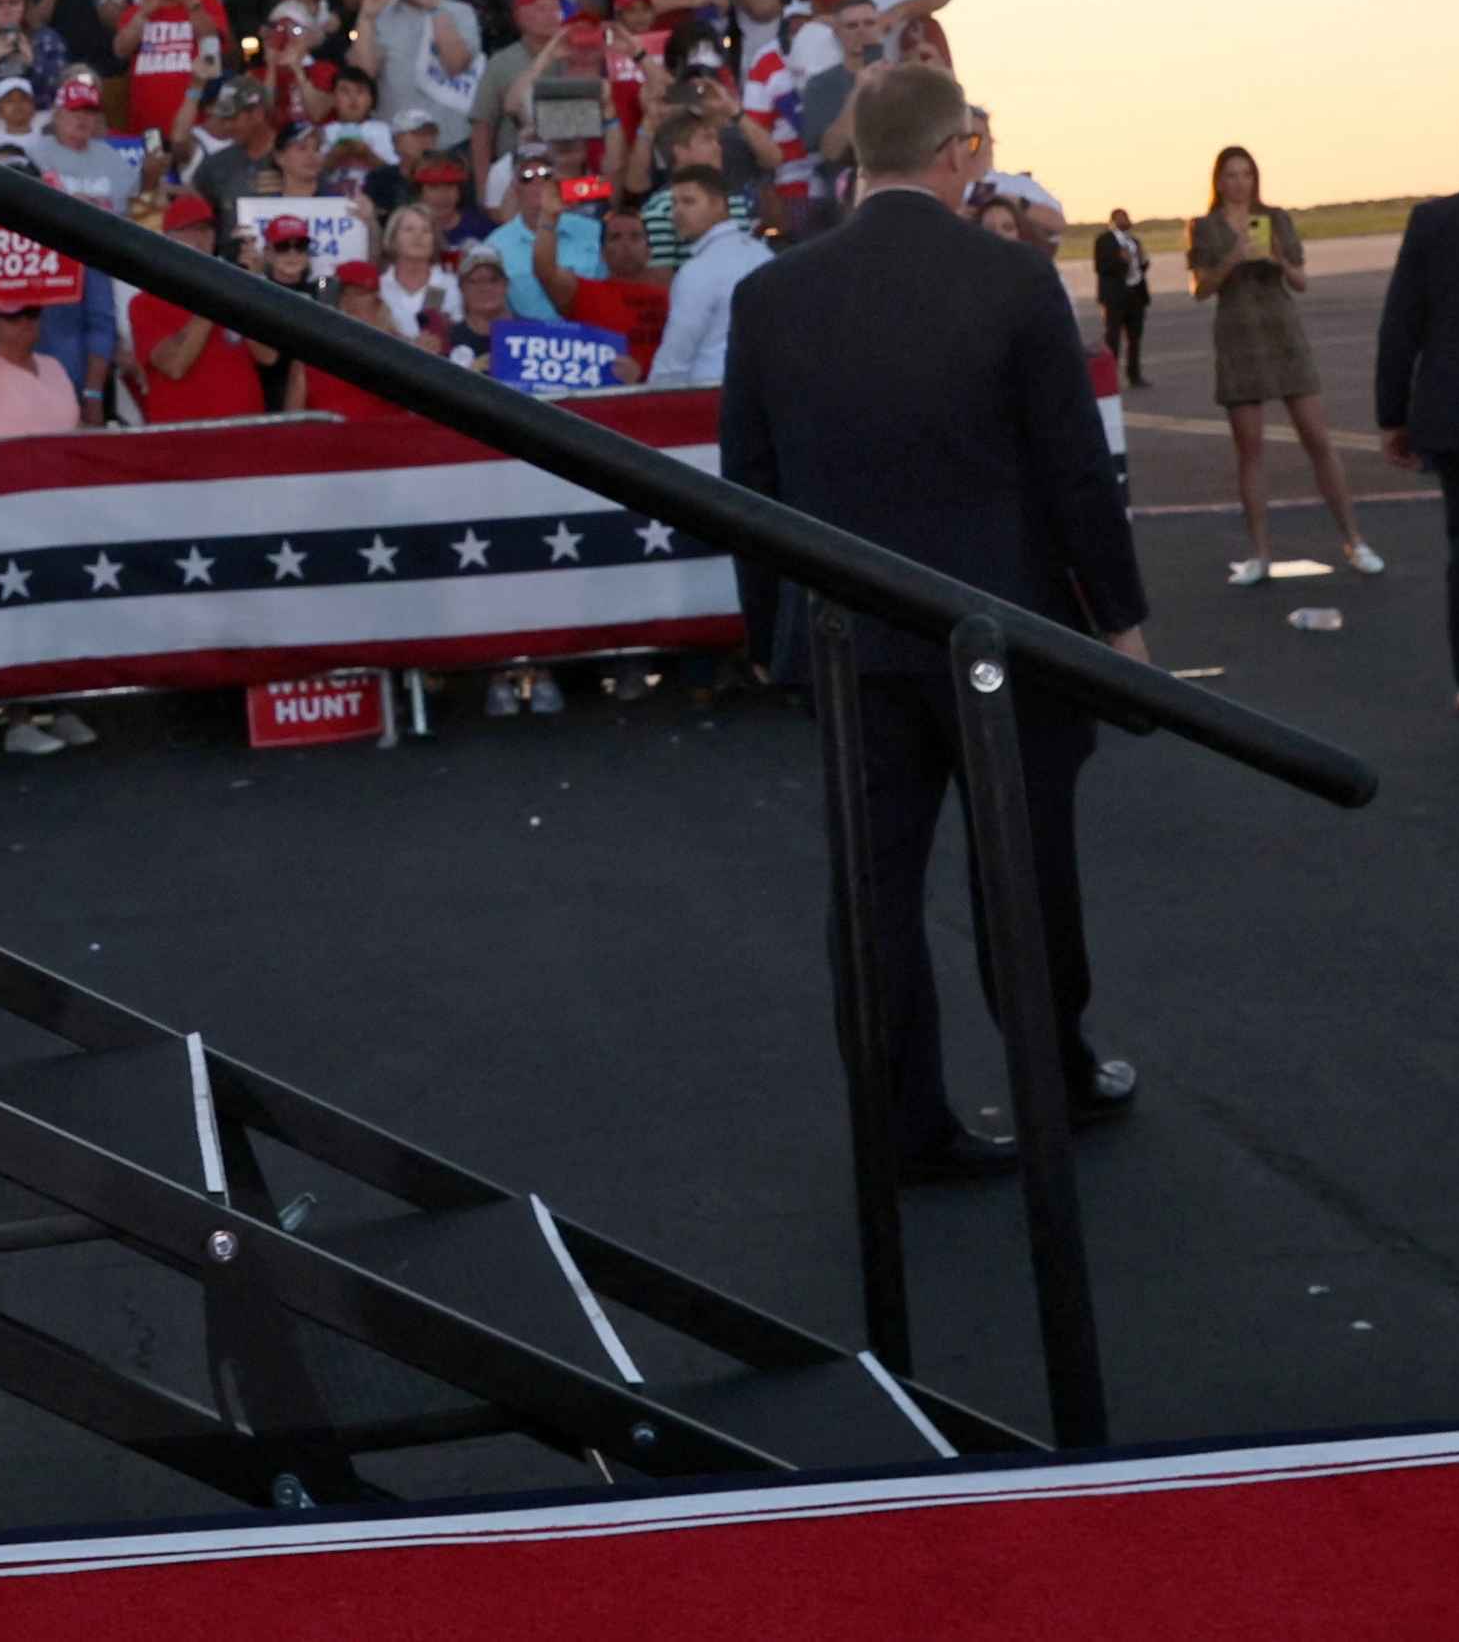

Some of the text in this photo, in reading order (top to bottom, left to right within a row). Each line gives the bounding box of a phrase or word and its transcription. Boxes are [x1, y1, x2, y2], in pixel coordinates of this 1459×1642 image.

[504, 335, 617, 366] TRUMP
[520, 357, 601, 388] 2024
[275, 691, 364, 725] HUNT
